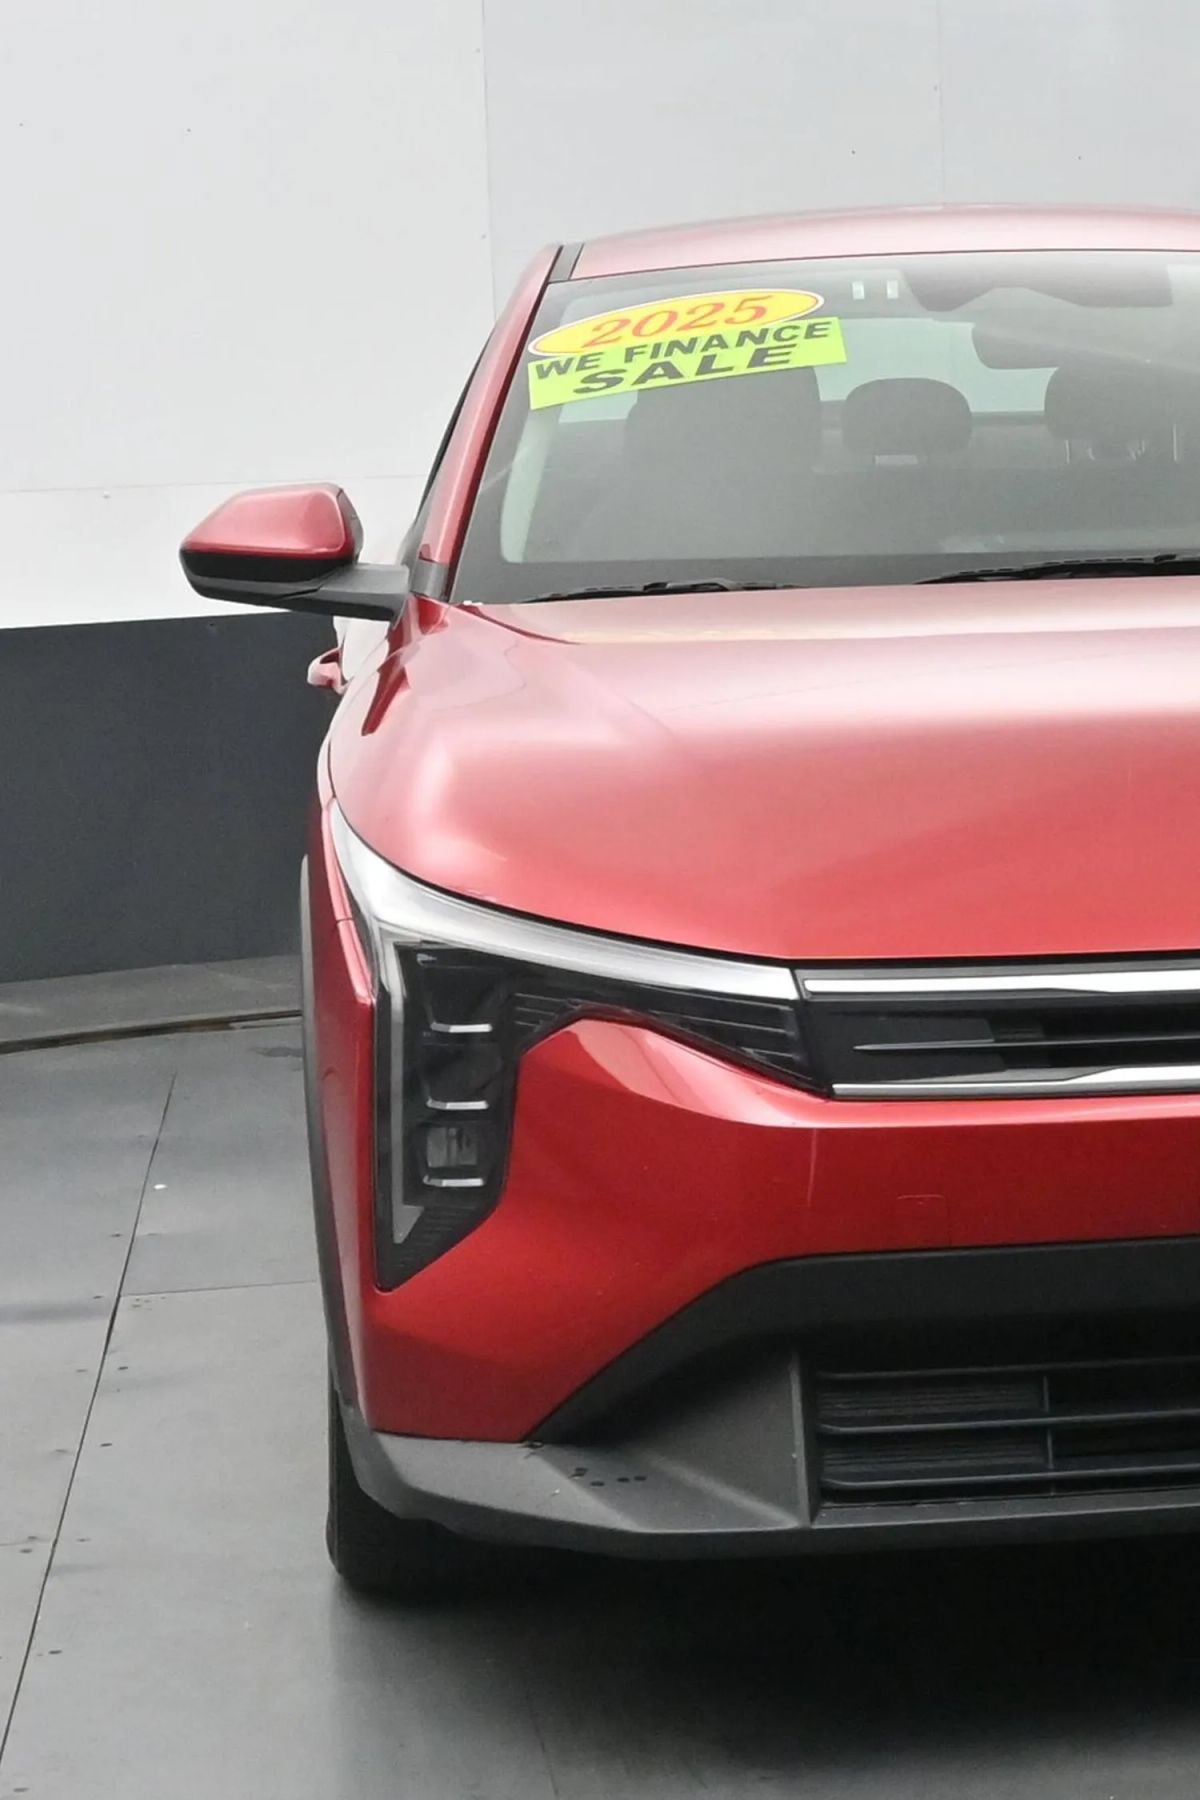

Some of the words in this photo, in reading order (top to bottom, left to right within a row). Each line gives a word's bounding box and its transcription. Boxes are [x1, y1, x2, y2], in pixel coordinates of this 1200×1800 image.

[580, 294, 775, 349] 2025
[535, 351, 608, 381] WE
[623, 321, 832, 364] FINANCE
[573, 343, 797, 394] SALE
